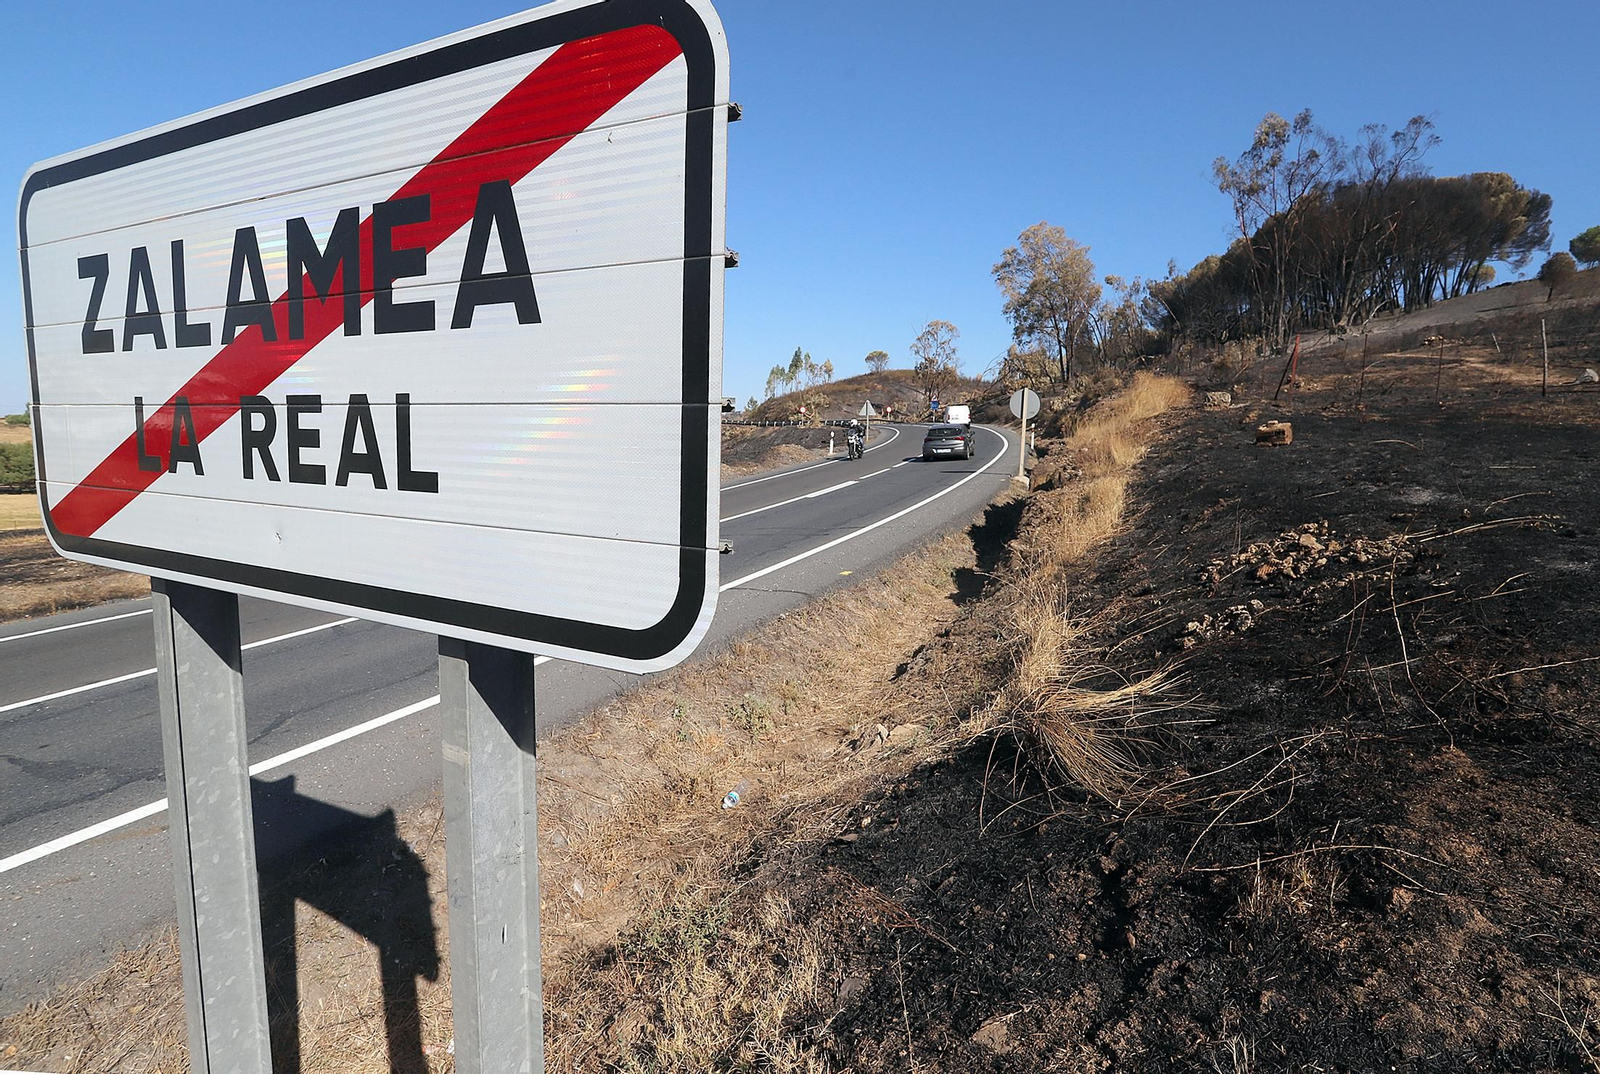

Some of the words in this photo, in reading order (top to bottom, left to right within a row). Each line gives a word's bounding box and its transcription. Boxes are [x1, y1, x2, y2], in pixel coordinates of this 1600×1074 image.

[78, 179, 541, 355] ZALAMEA
[134, 396, 205, 476] LA
[241, 393, 439, 493] REAL
